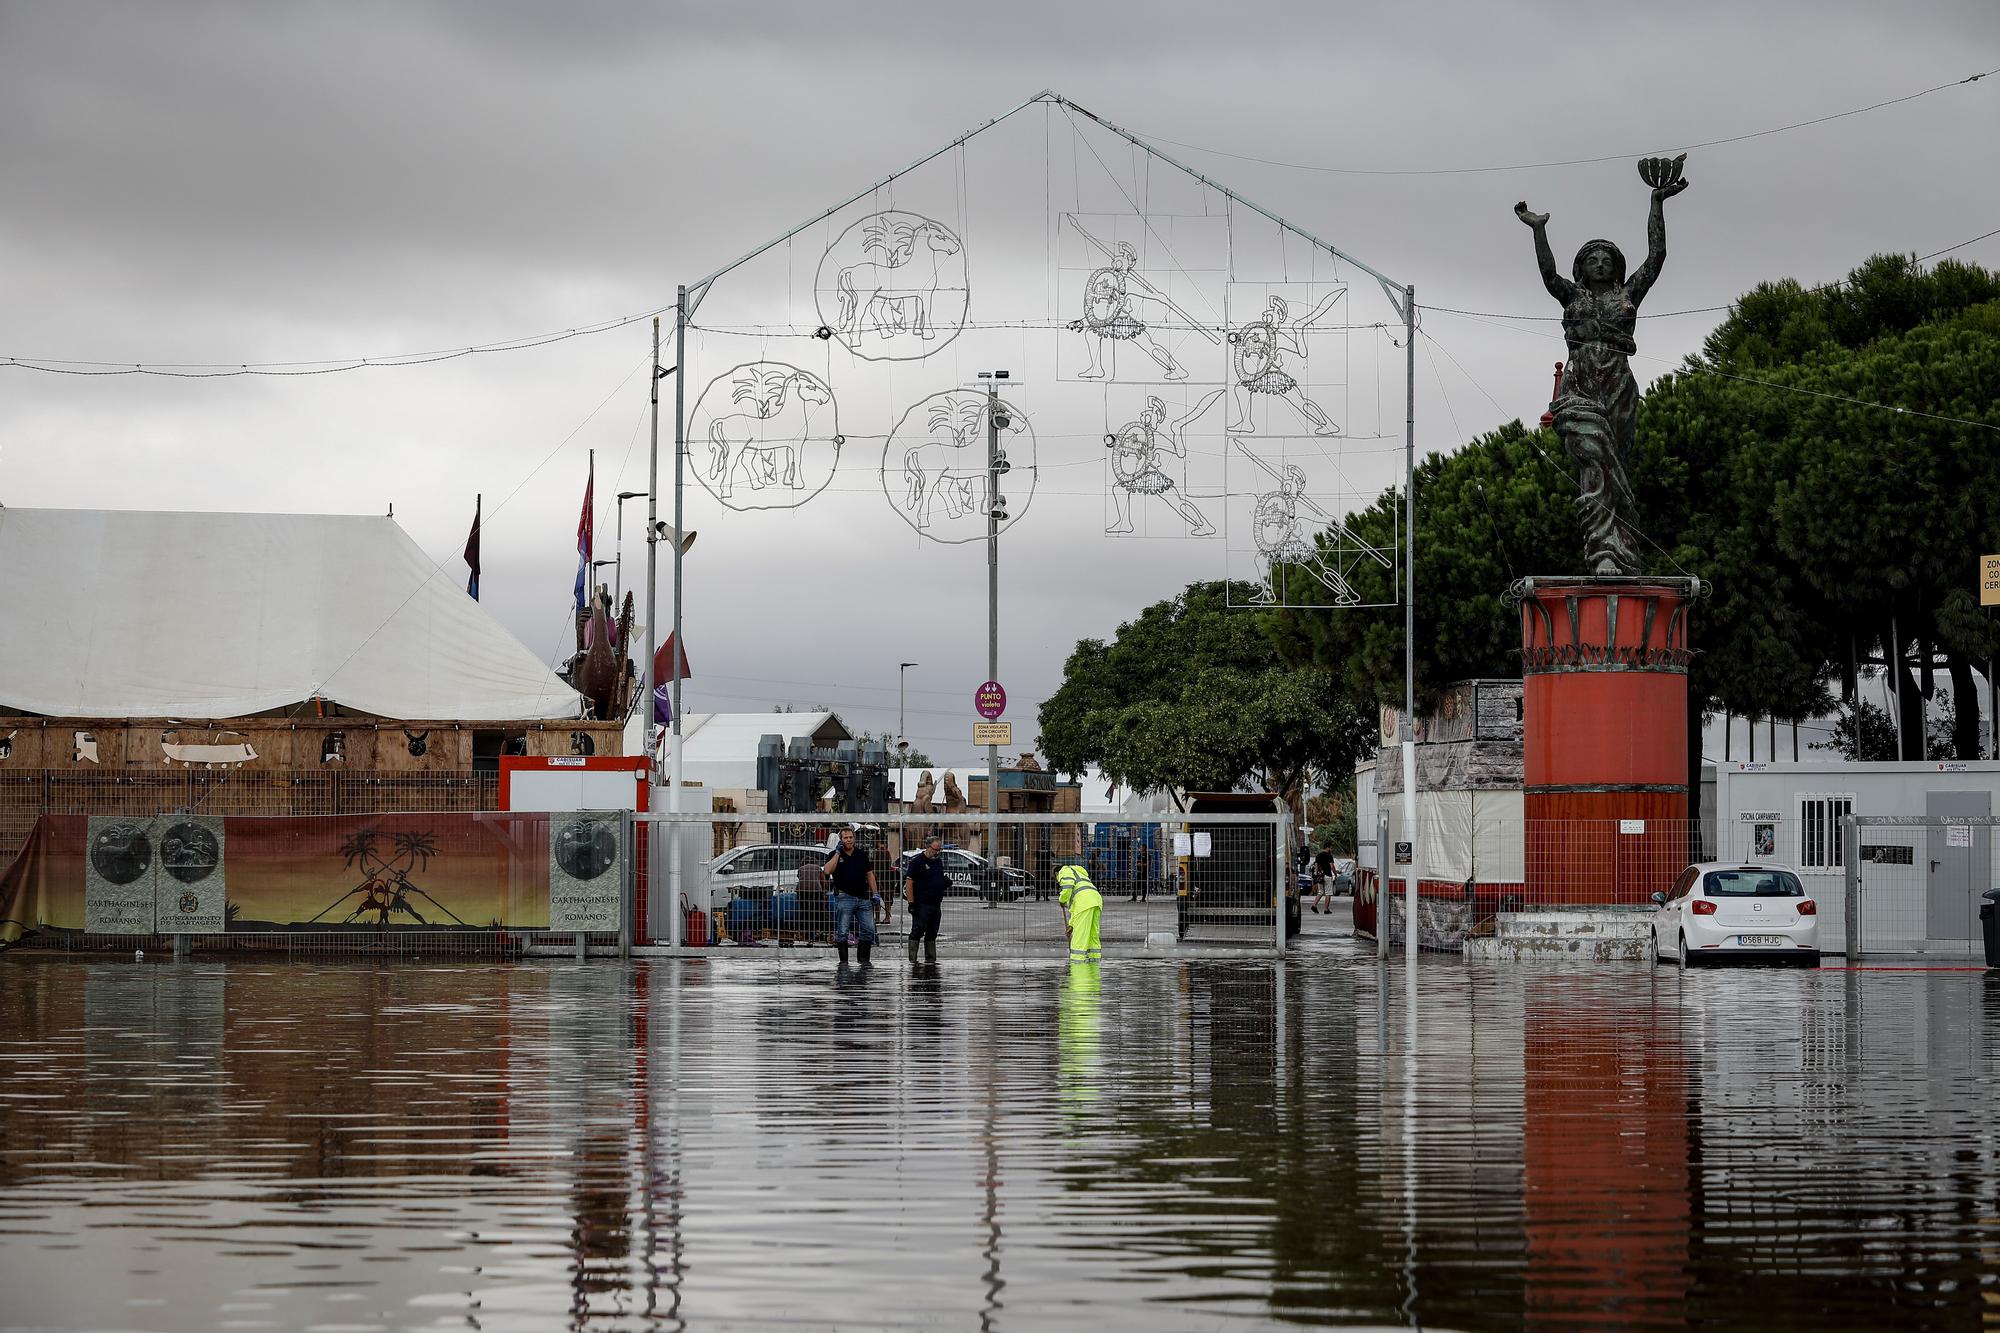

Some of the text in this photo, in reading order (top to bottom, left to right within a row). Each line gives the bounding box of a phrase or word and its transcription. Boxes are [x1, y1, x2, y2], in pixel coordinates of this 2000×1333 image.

[1985, 581, 2000, 589] CER
[982, 700, 1001, 708] violeta
[1740, 812, 1781, 820] OFICINA CAMPAMENTO
[87, 900, 154, 908] CARTHAGINESES
[552, 896, 620, 904] CARTHAGINESES
[118, 908, 122, 916] Y
[100, 917, 141, 925] ROMANOS
[565, 913, 608, 921] ROMANOS
